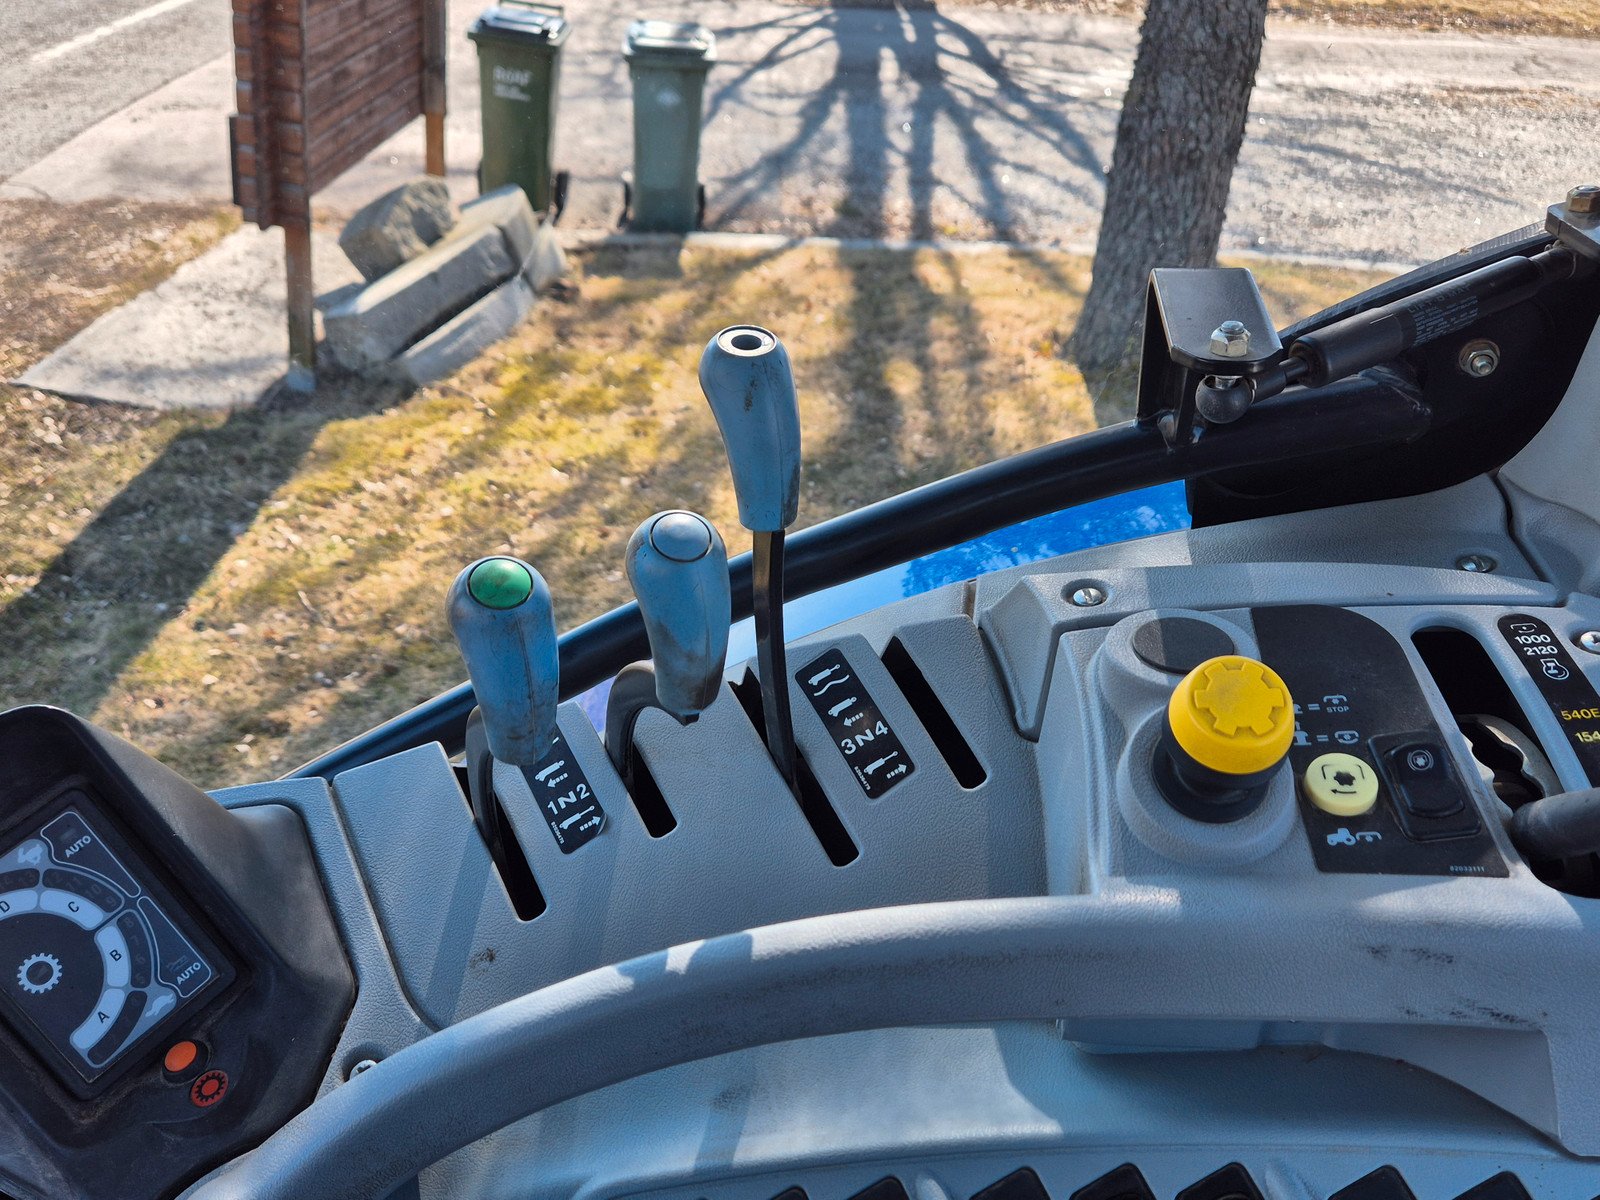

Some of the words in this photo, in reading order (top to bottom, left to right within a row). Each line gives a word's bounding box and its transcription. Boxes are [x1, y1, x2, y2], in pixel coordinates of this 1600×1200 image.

[1514, 634, 1551, 645] 1000
[1523, 645, 1558, 656] 2120
[1326, 705, 1350, 713] STOP
[1561, 708, 1600, 720] 540E
[65, 835, 91, 858] AUTO
[0, 901, 10, 913] D
[68, 901, 79, 913] C
[109, 949, 122, 962] B
[175, 962, 201, 985] AUTO
[97, 1011, 110, 1024] A
